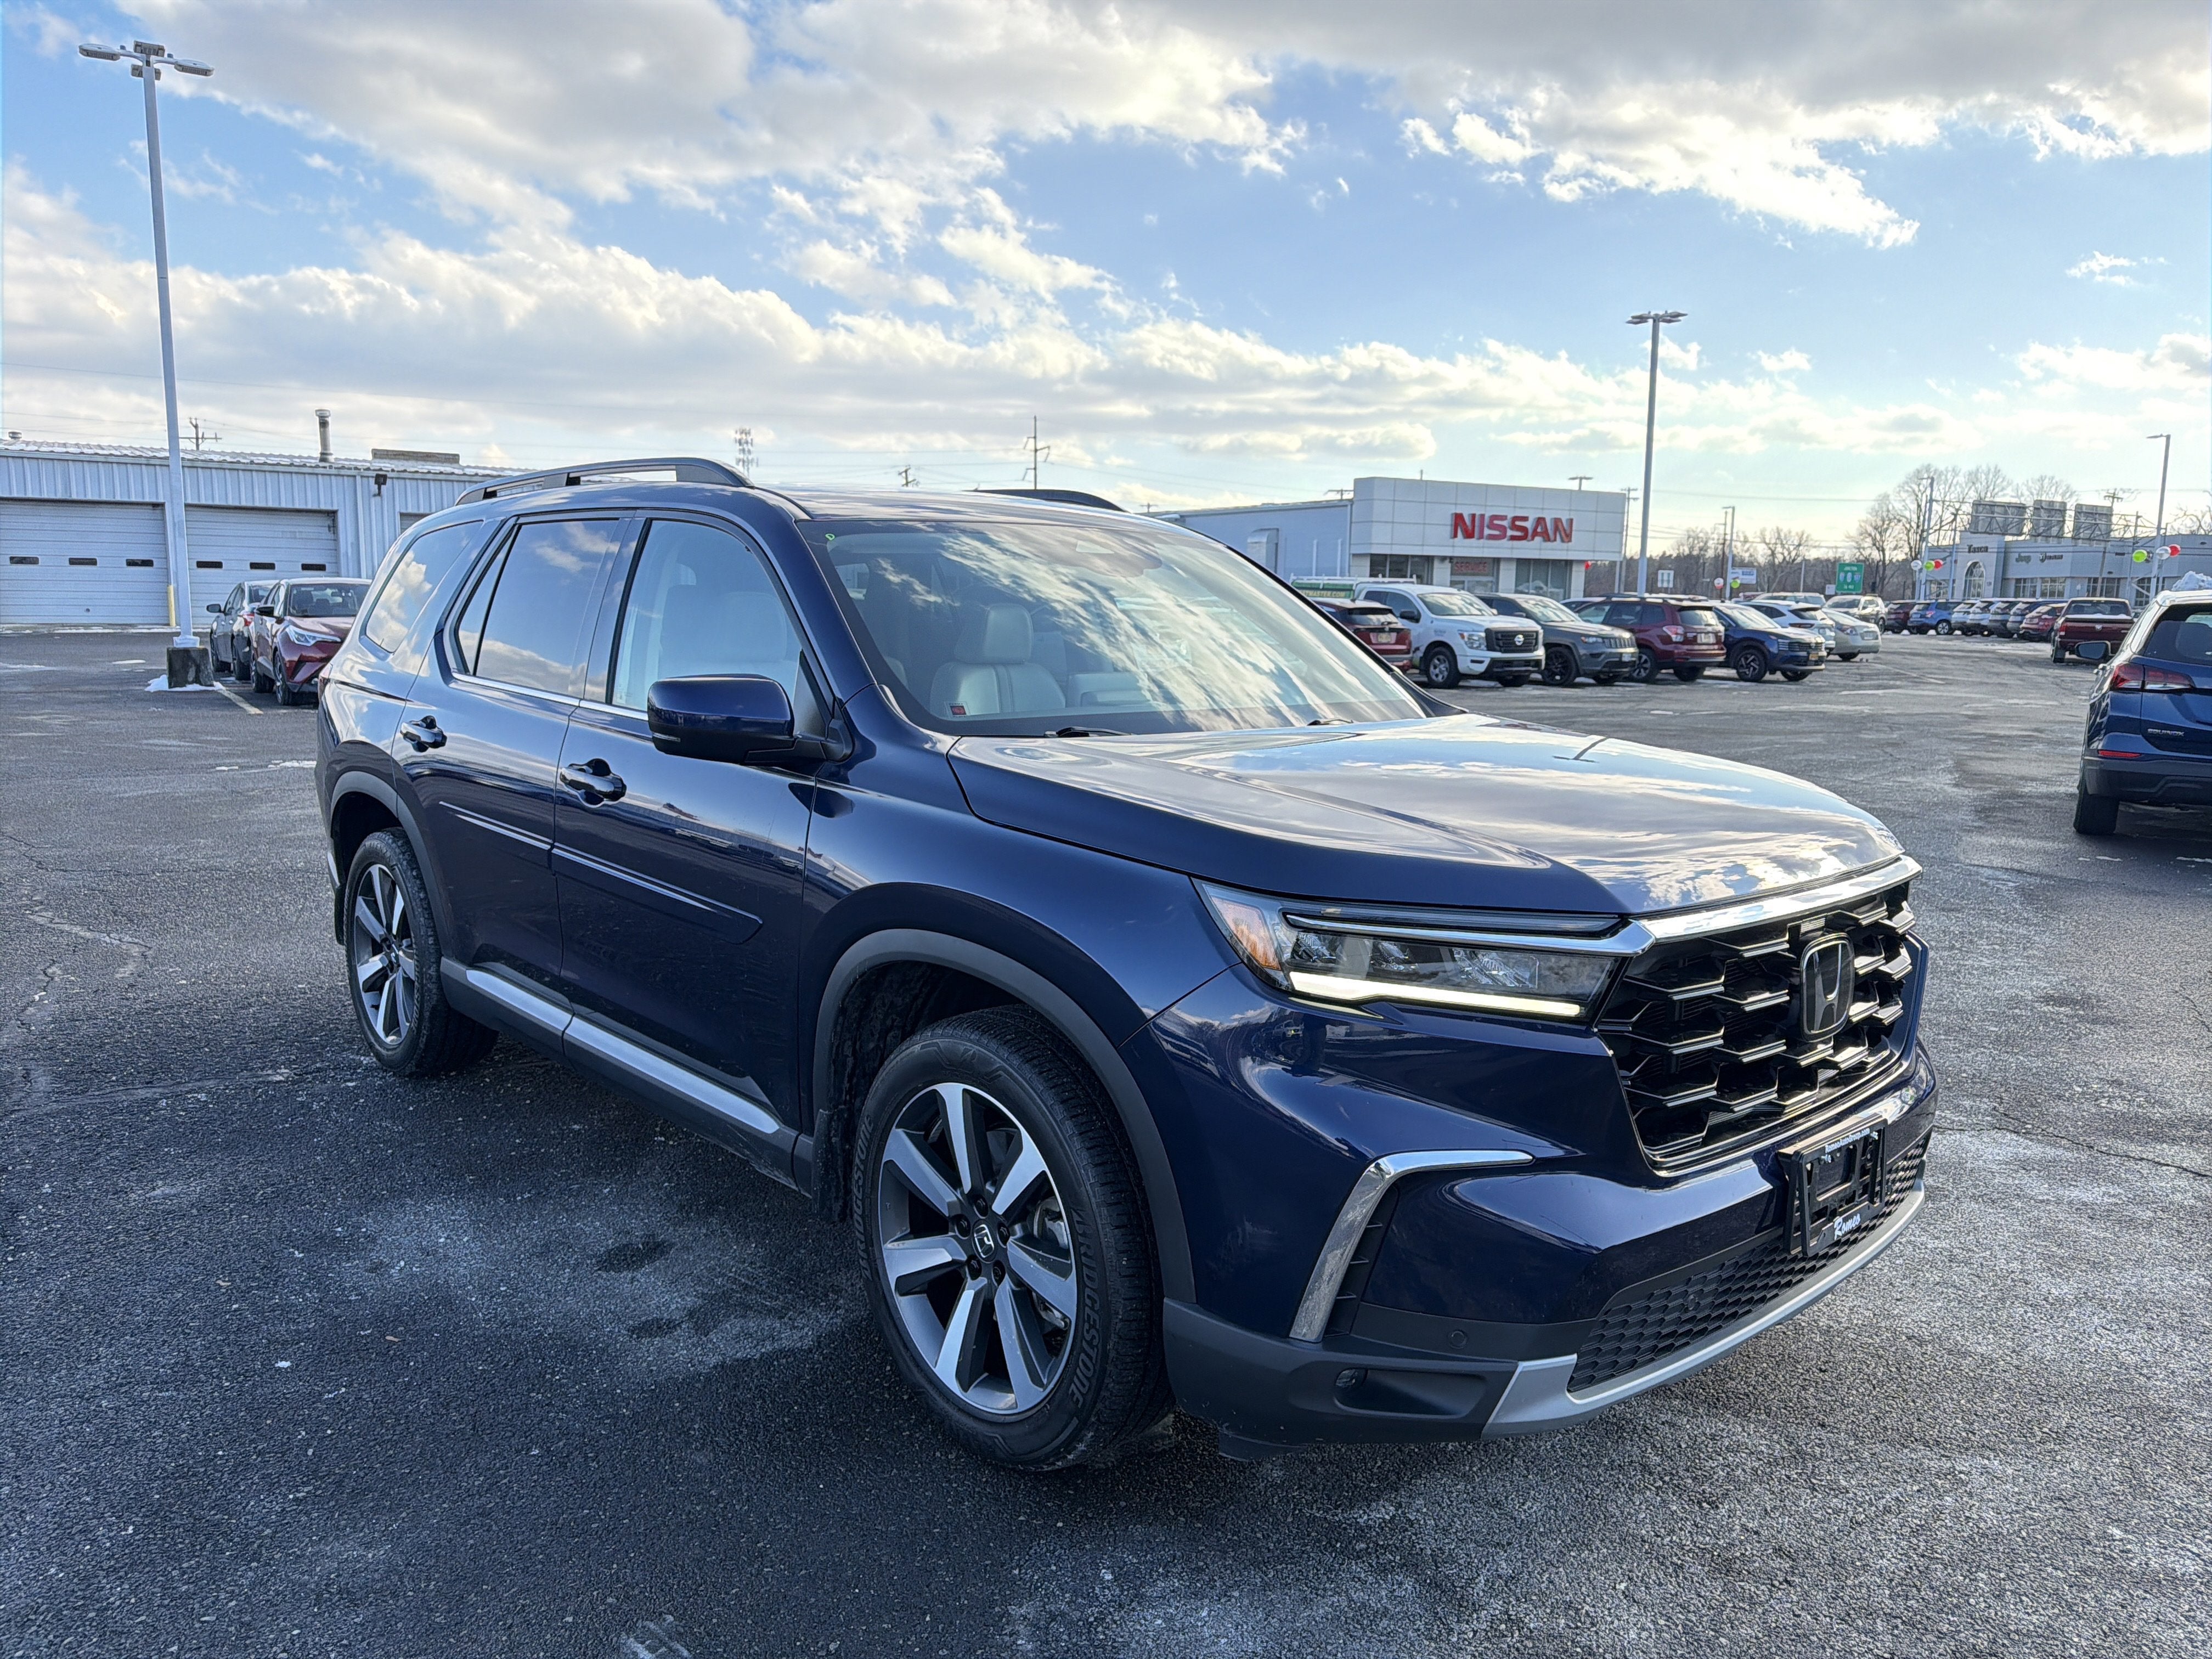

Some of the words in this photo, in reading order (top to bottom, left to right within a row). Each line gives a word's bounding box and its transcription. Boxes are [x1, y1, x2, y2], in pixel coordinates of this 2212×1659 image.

[1451, 512, 1573, 543] NISSAN
[1834, 1213, 1860, 1240] Romeo
[1070, 1209, 1099, 1408] BRIDGESTONE
